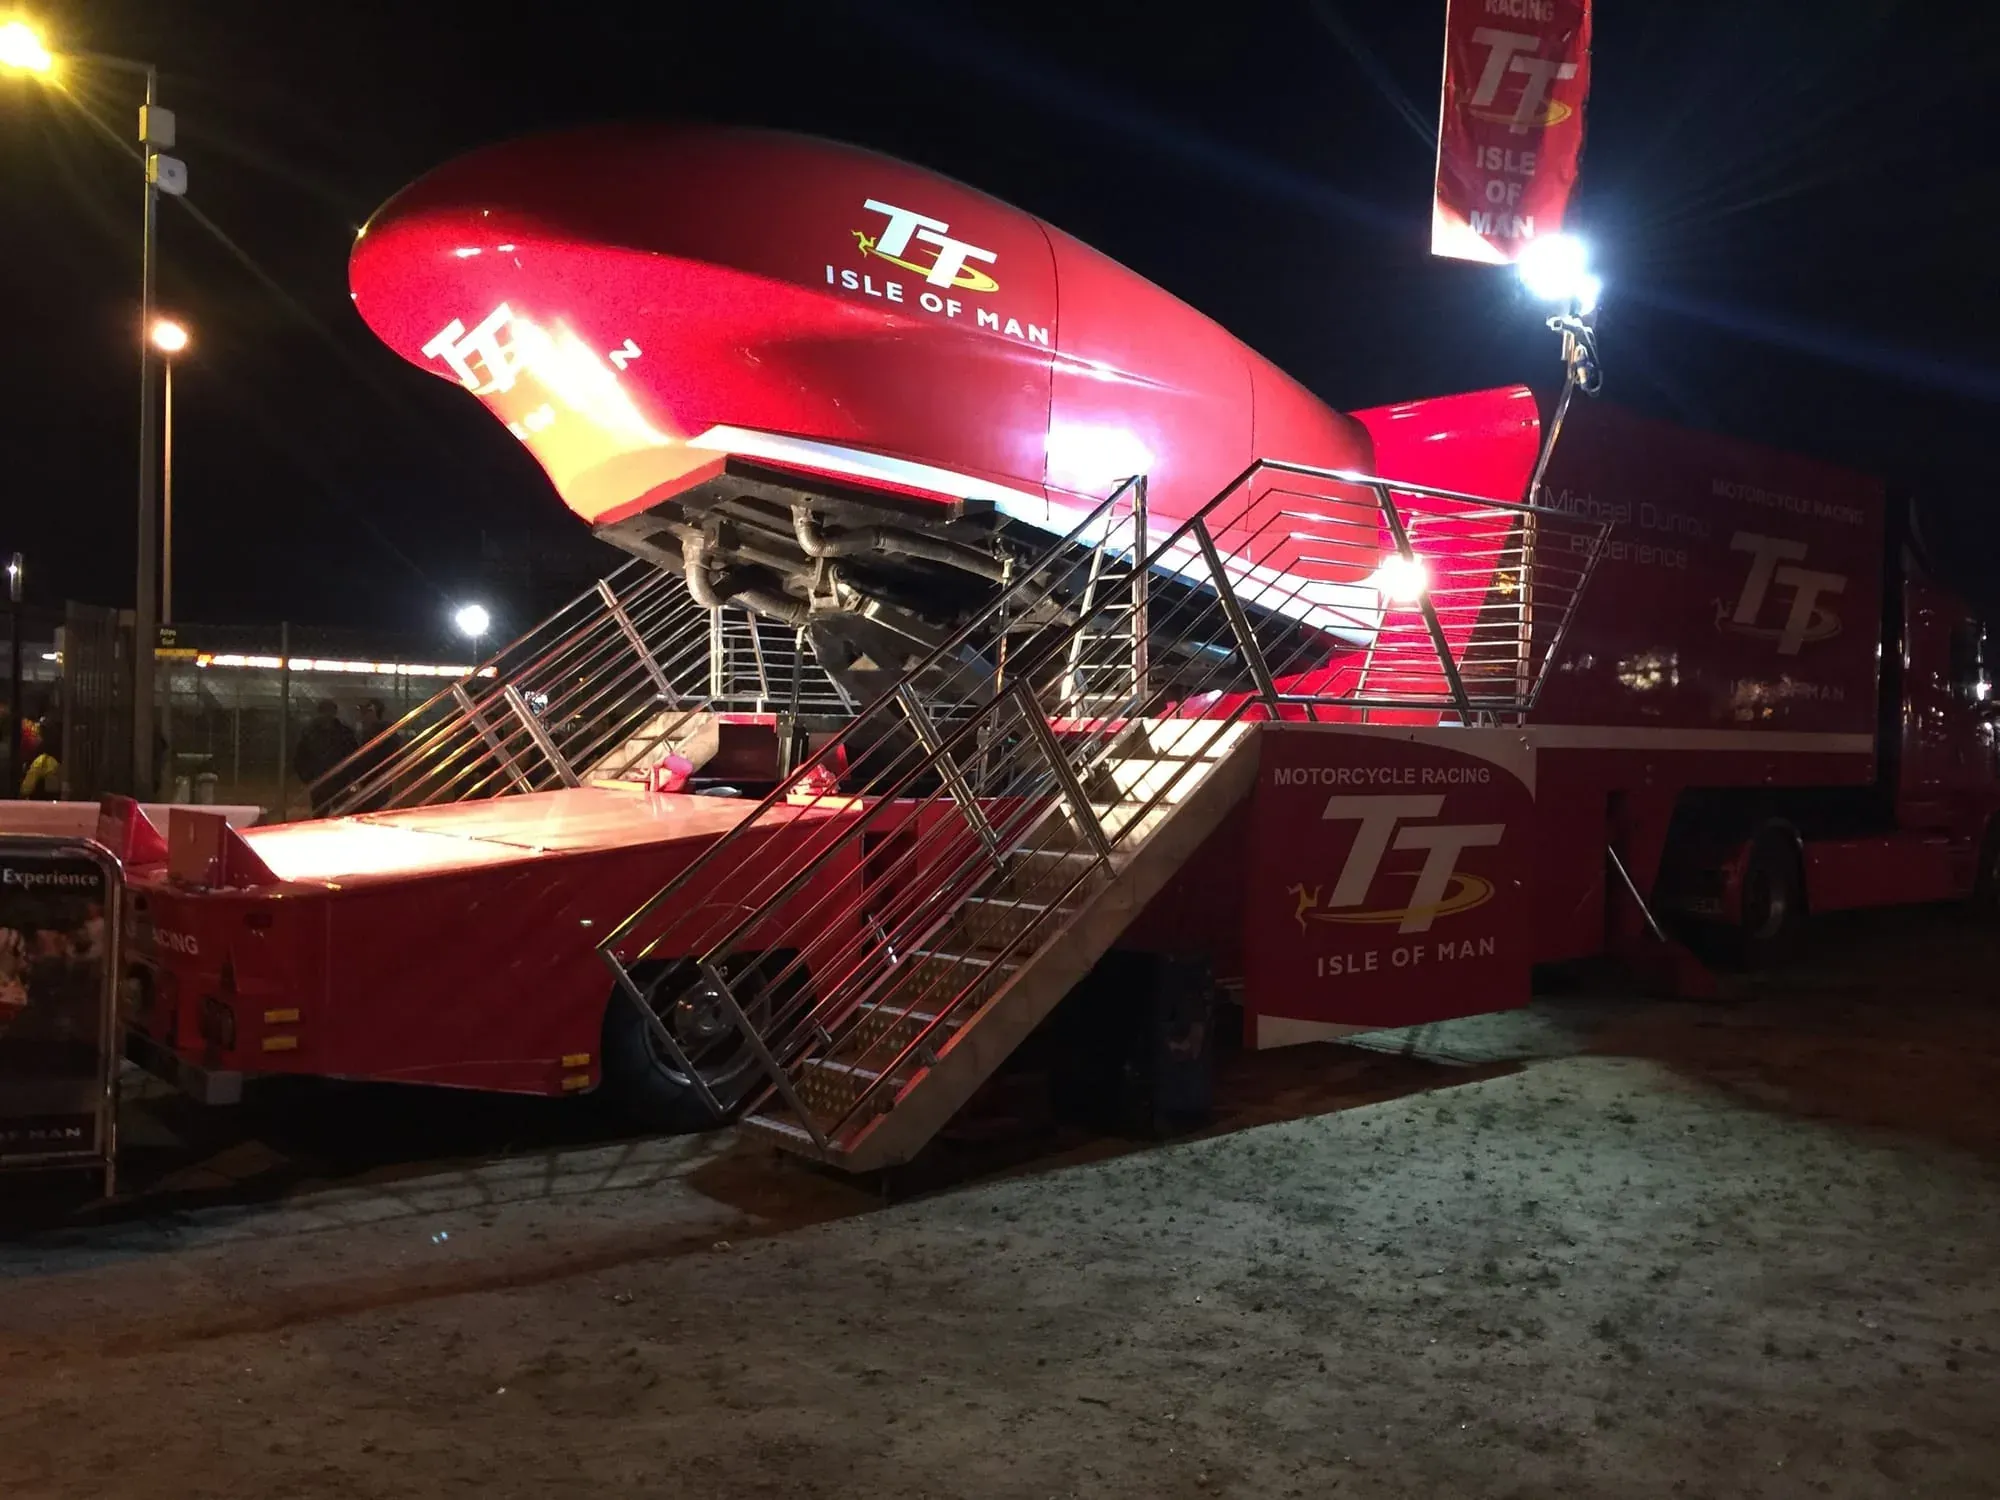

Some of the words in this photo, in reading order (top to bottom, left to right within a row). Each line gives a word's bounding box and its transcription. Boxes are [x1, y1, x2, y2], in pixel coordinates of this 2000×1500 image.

[1485, 0, 1554, 21] RACING
[1476, 145, 1536, 176] ISLE
[1486, 180, 1522, 206] OF
[1470, 210, 1535, 239] MAN
[863, 198, 998, 289] TT
[825, 264, 904, 303] ISLE
[919, 292, 962, 318] OF
[976, 308, 1050, 346] MAN
[1544, 484, 1633, 524] Michael
[1570, 533, 1689, 571] experience
[1729, 530, 1848, 656] TT
[1806, 685, 1845, 701] MAN
[1274, 767, 1417, 785] MOTORCYCLE
[1421, 767, 1491, 784] RACING
[3, 867, 100, 891] Experience
[1322, 794, 1506, 934] TT
[1317, 951, 1379, 978] ISLE
[1392, 946, 1426, 967] OF
[1438, 937, 1496, 961] MAN
[28, 1127, 81, 1139] MAN
